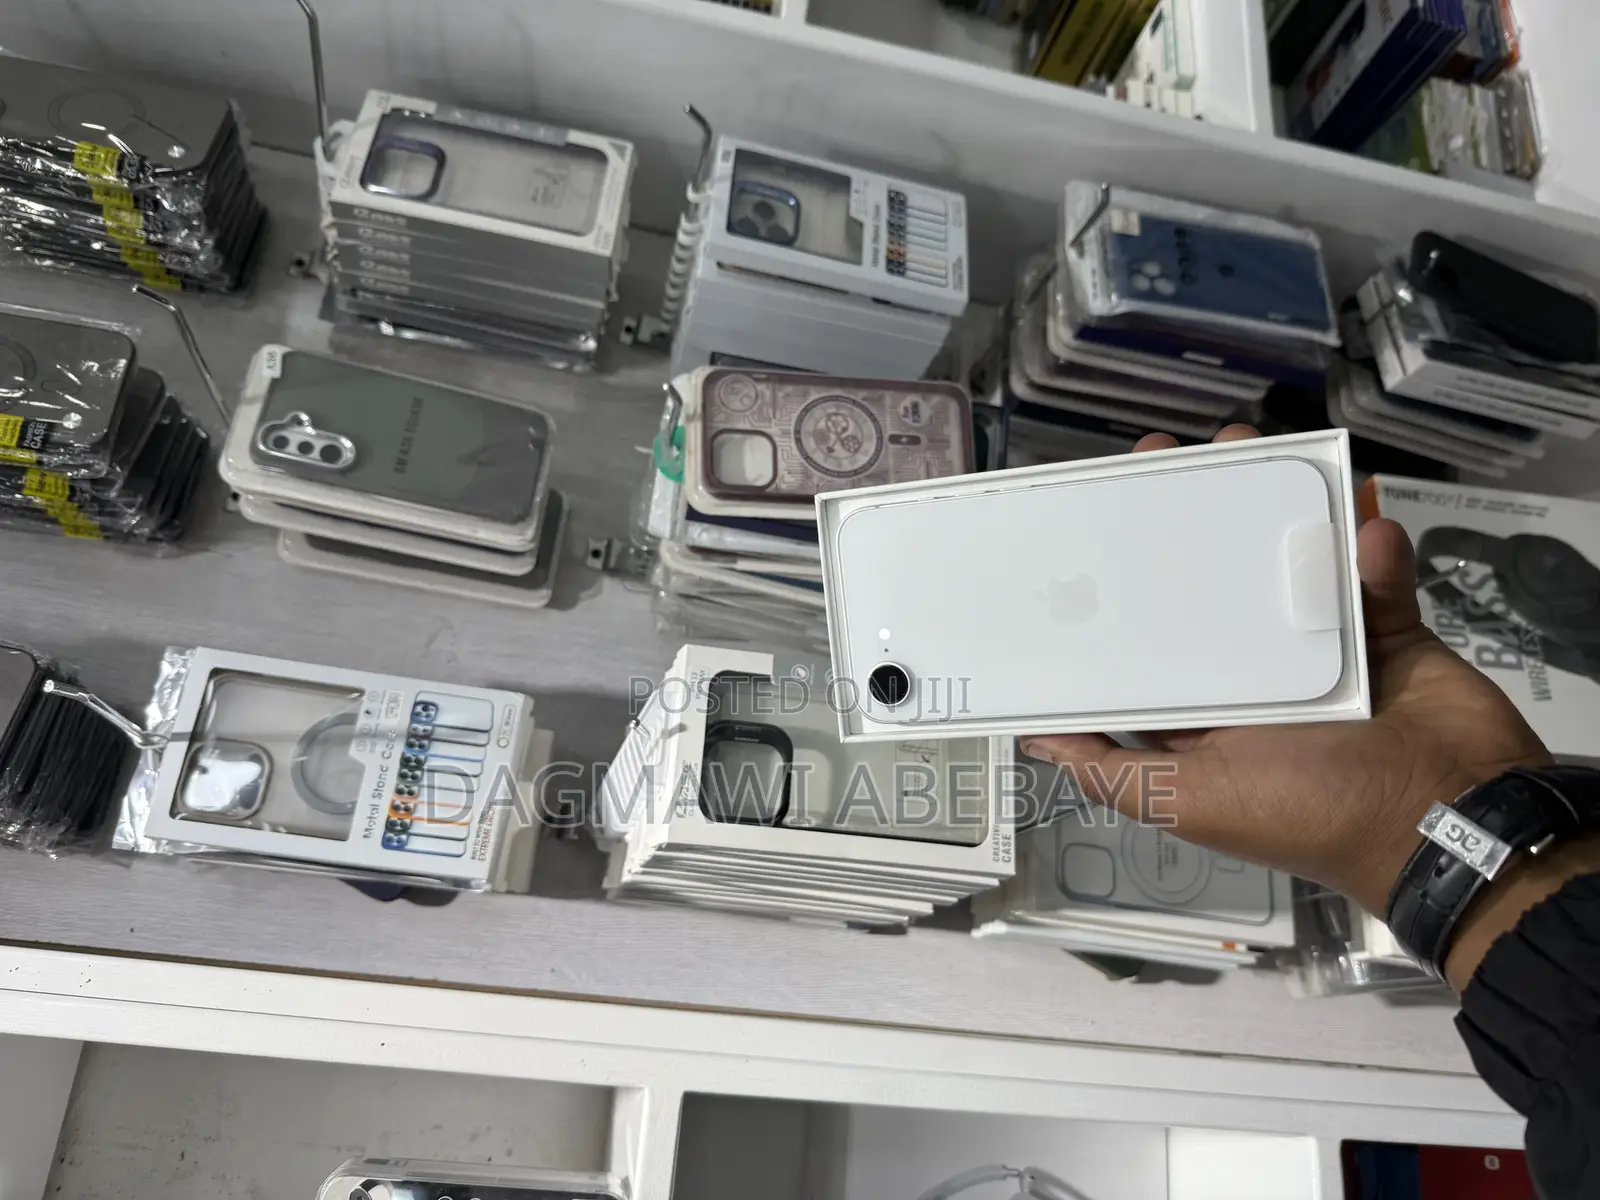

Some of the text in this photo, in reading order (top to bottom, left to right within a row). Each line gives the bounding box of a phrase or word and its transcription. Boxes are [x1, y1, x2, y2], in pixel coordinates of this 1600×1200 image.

[30, 421, 48, 449] CASE
[1431, 598, 1470, 649] URE
[1457, 567, 1526, 672] BASS
[1001, 833, 1012, 864] CASE
